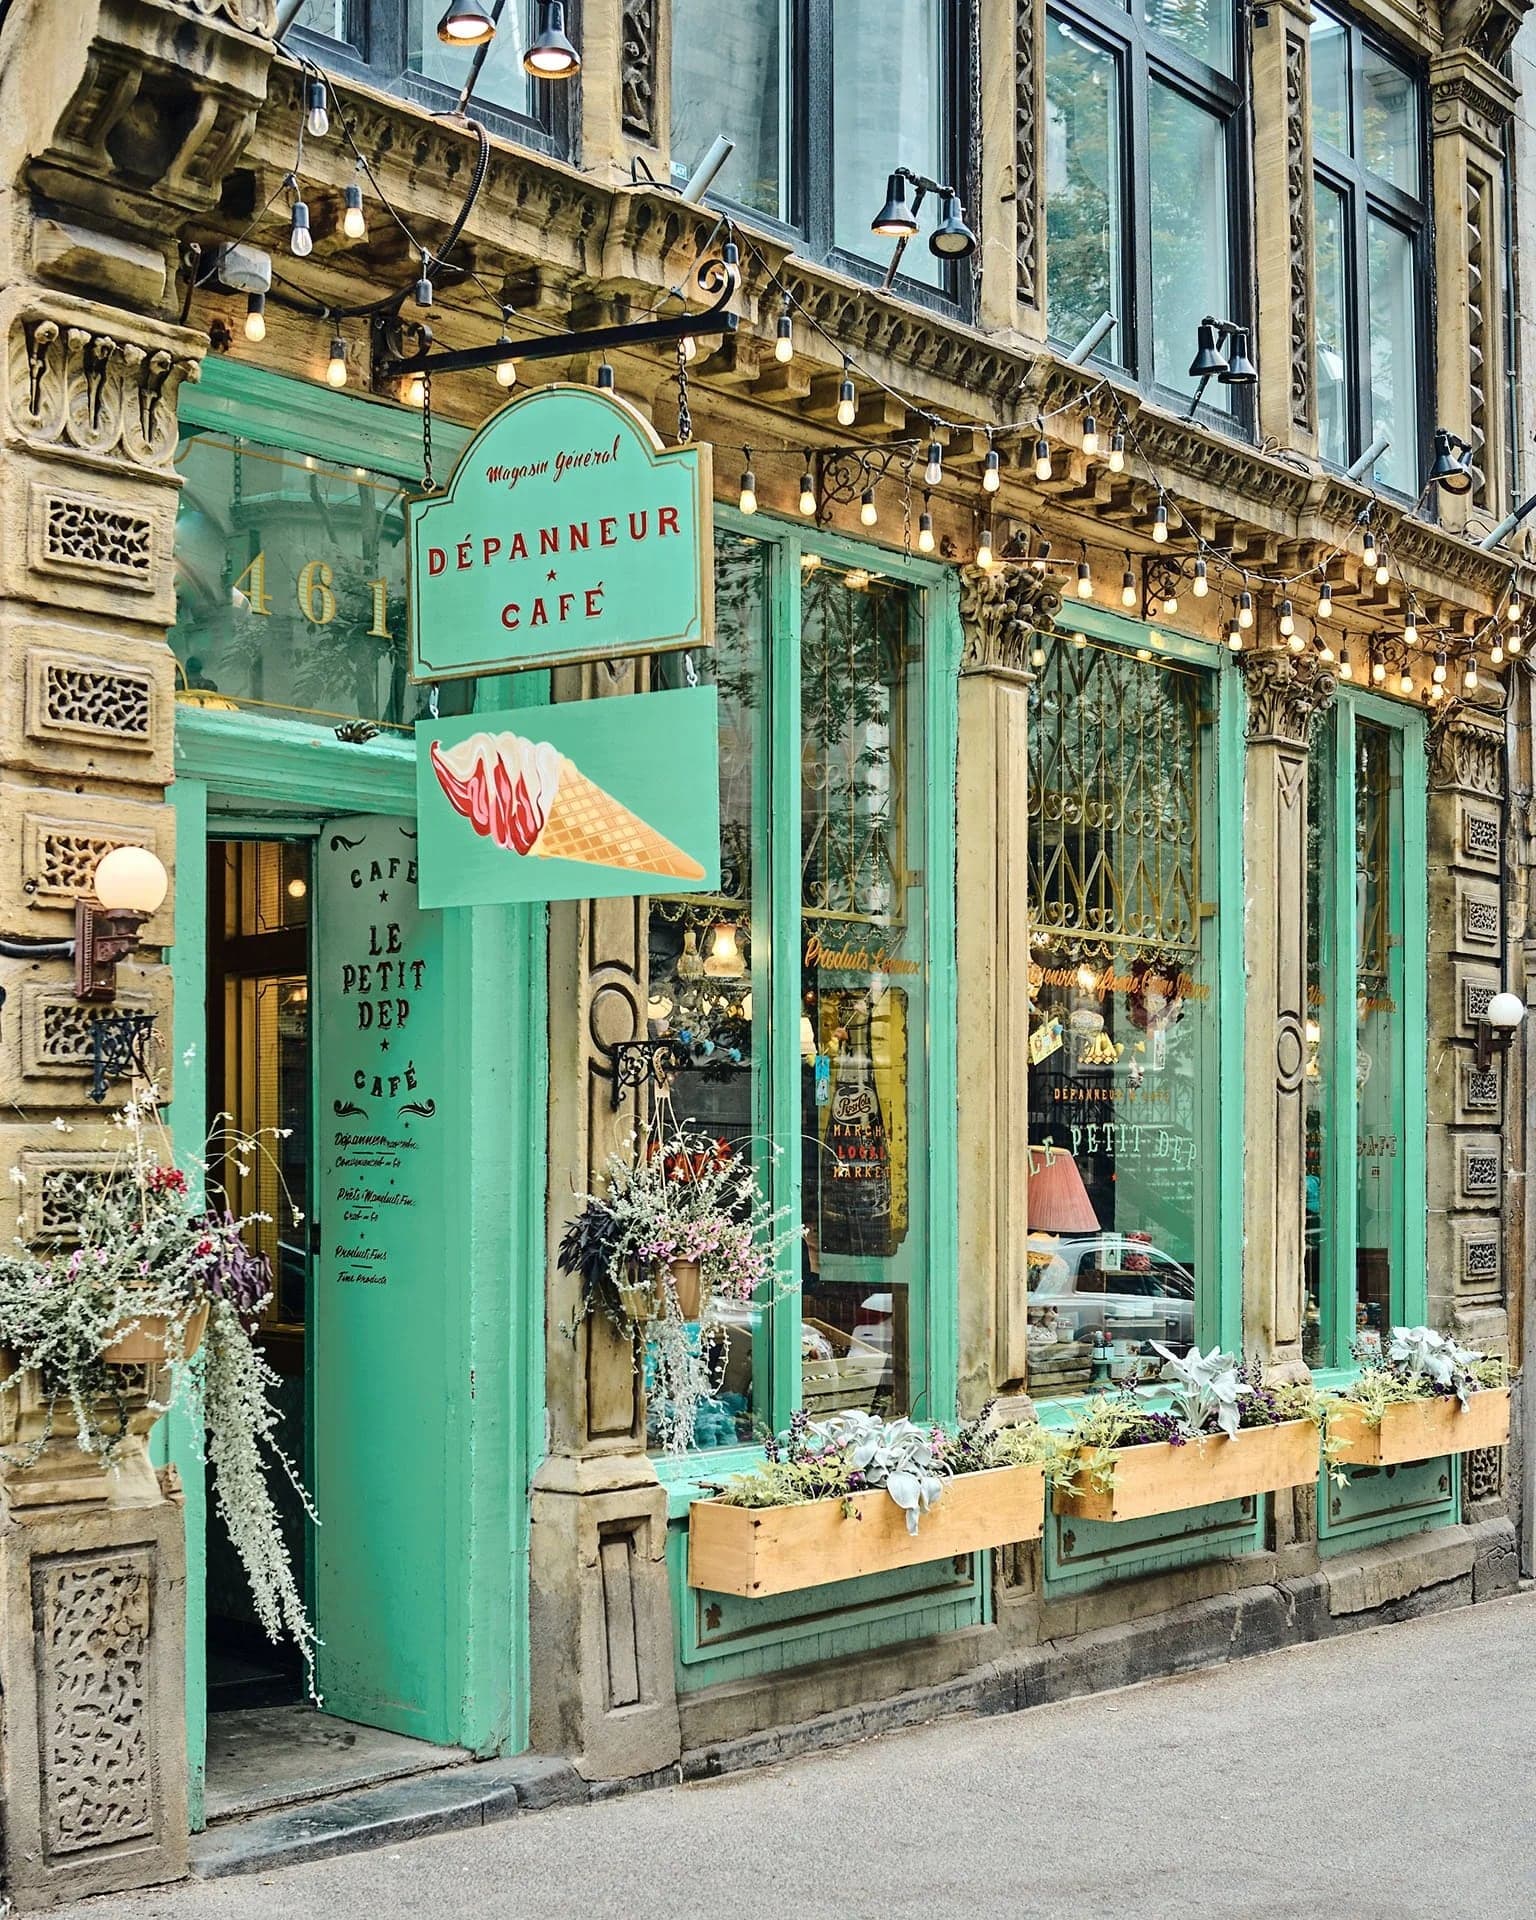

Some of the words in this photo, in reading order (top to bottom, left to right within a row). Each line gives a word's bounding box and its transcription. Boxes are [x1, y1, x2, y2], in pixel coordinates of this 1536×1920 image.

[486, 461, 548, 489] Magasin
[554, 434, 620, 482] Général
[428, 507, 680, 576] DÉPANNEUR
[501, 581, 604, 631] CAFÉ
[369, 923, 402, 956] LE
[342, 960, 425, 994] PETIT
[358, 998, 409, 1031] DEP
[354, 1060, 418, 1098] CAFÉ
[1071, 1122, 1143, 1157] PETIT
[1158, 1129, 1197, 1170] DEP
[833, 1166, 891, 1179] MARKET
